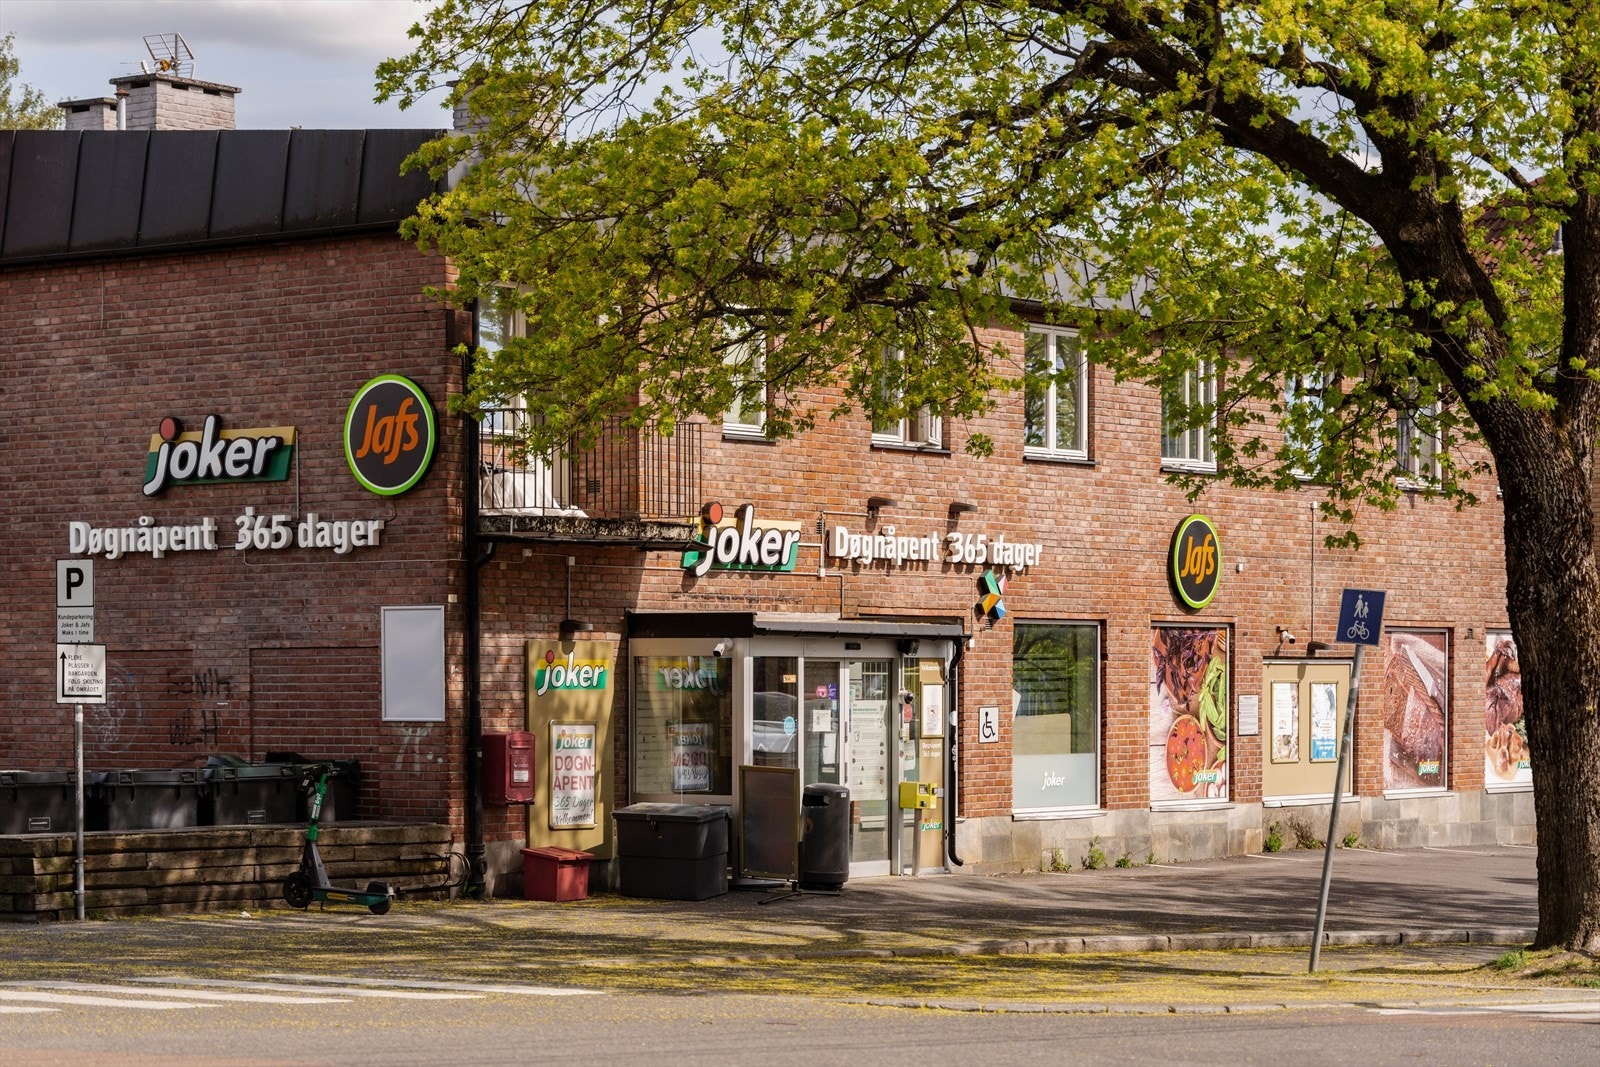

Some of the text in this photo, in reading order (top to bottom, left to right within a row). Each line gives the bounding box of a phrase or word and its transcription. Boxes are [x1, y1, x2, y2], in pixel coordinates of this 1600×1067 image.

[355, 397, 419, 465] Jafs
[142, 414, 284, 497] joker
[69, 511, 385, 560] Døgnåpent 365 dager
[695, 502, 801, 577] joker
[830, 525, 1043, 572] Døgnåpent 365 dager
[1181, 533, 1215, 584] Jafs
[66, 567, 84, 600] P
[537, 650, 605, 696] joker
[558, 729, 591, 753] joker
[554, 754, 595, 772] DØGN-
[1193, 766, 1216, 785] joker
[1418, 759, 1438, 776] joker
[553, 771, 594, 791] ÅPENT
[1041, 771, 1065, 790] joker
[554, 795, 570, 808] 365
[922, 817, 941, 832] joker
